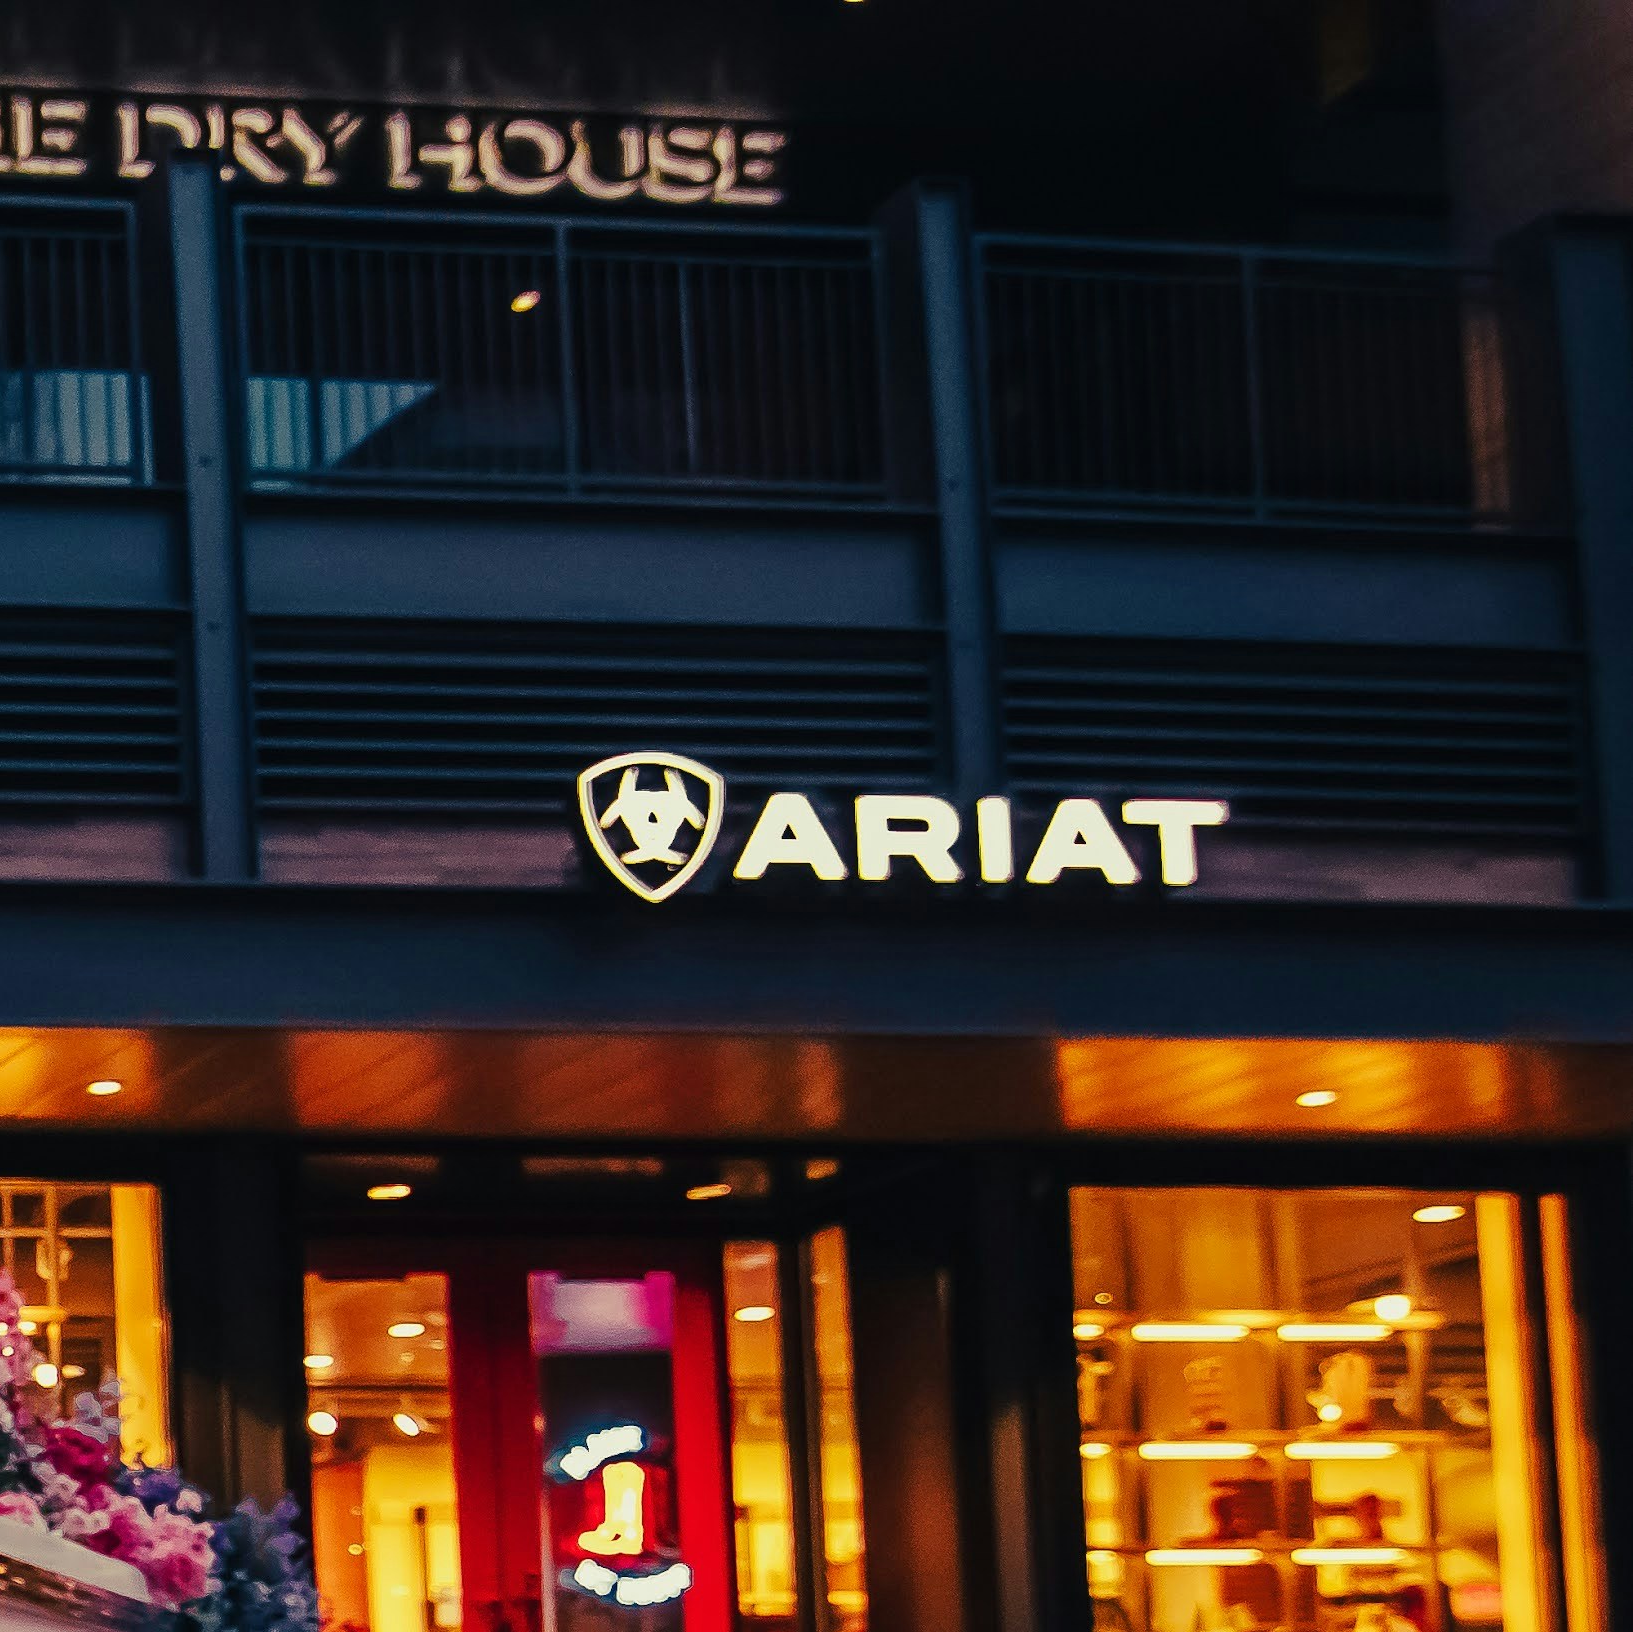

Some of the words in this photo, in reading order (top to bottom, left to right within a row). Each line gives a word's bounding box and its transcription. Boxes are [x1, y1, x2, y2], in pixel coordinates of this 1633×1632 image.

[118, 102, 364, 186] DRY
[385, 109, 786, 205] HOUSE
[734, 792, 1230, 886] ARIAT
